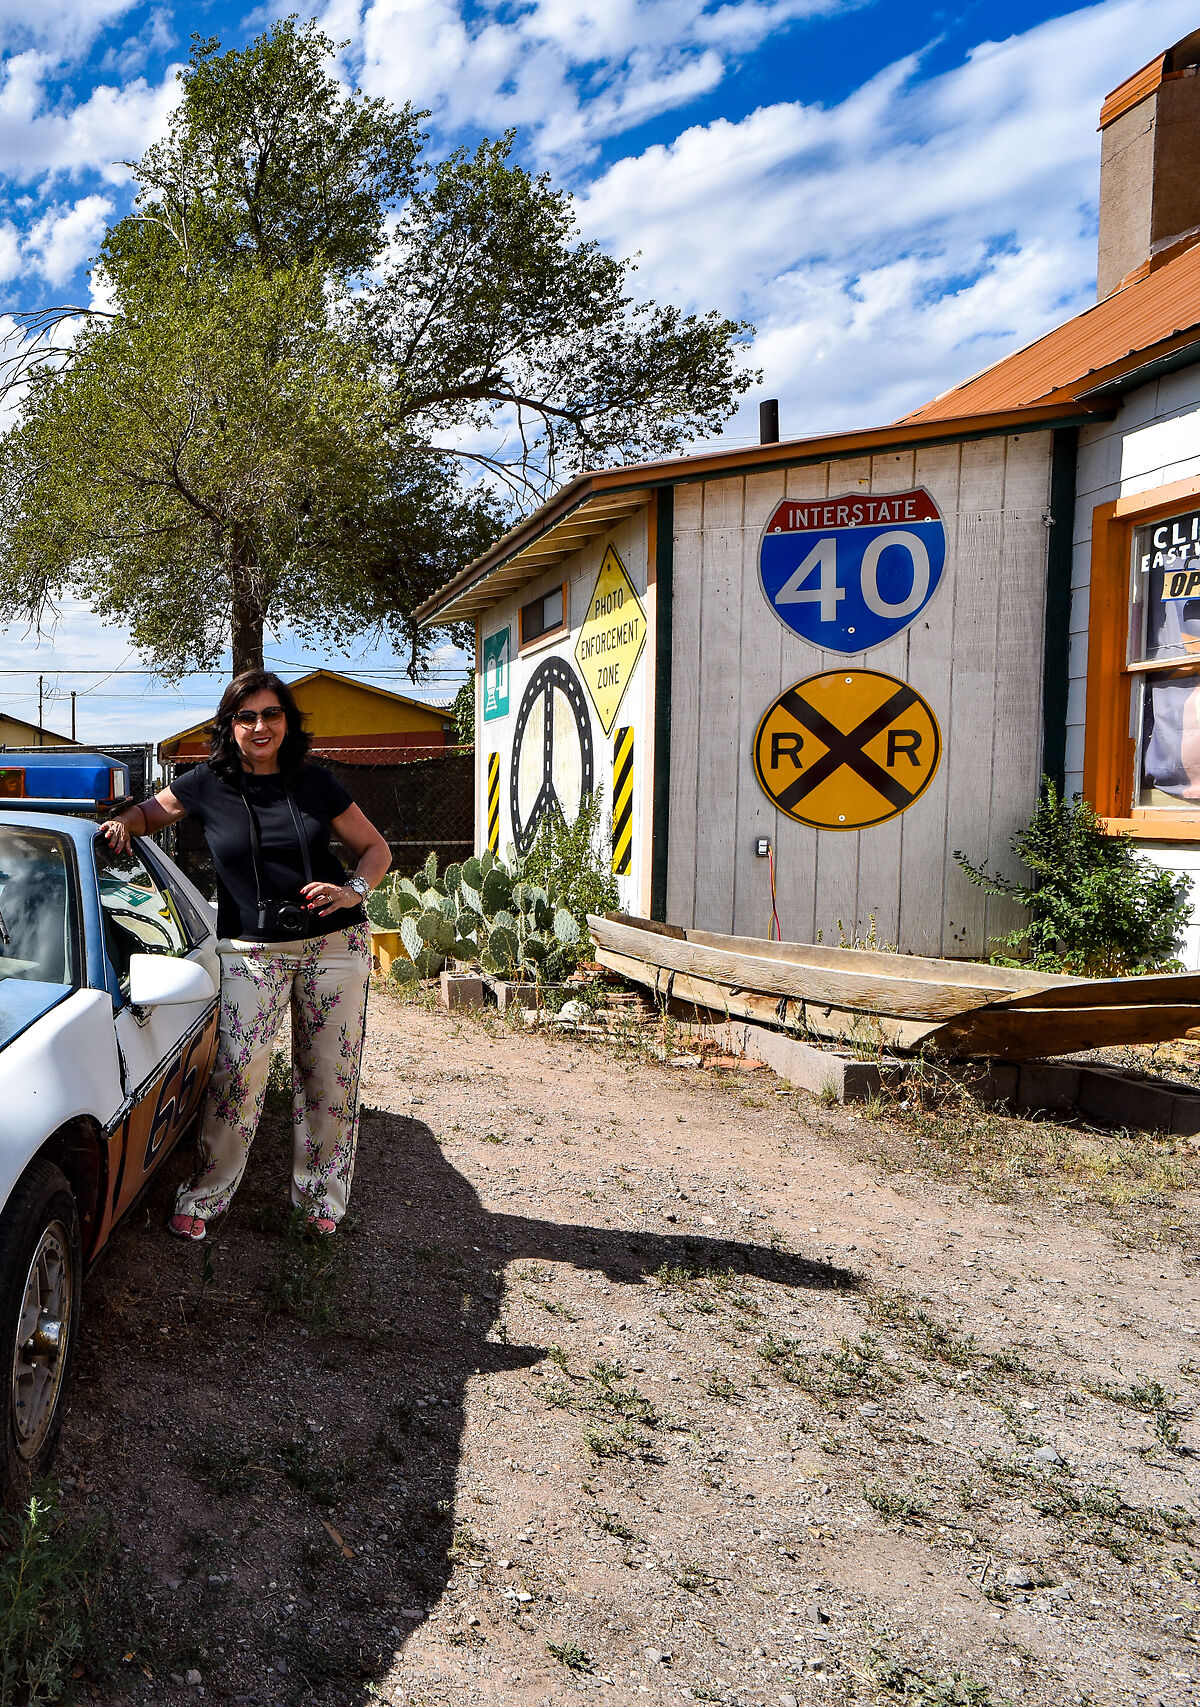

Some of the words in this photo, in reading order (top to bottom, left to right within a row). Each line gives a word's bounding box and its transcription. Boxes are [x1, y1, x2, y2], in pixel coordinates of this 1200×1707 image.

[788, 499, 917, 528] INTERSTATE
[1153, 517, 1199, 549] CLI
[775, 530, 930, 622] 40
[595, 587, 624, 620] PHOTO
[581, 618, 639, 661] ENFORCEMENT
[597, 662, 620, 690] ZONE
[143, 1026, 205, 1173] 66
